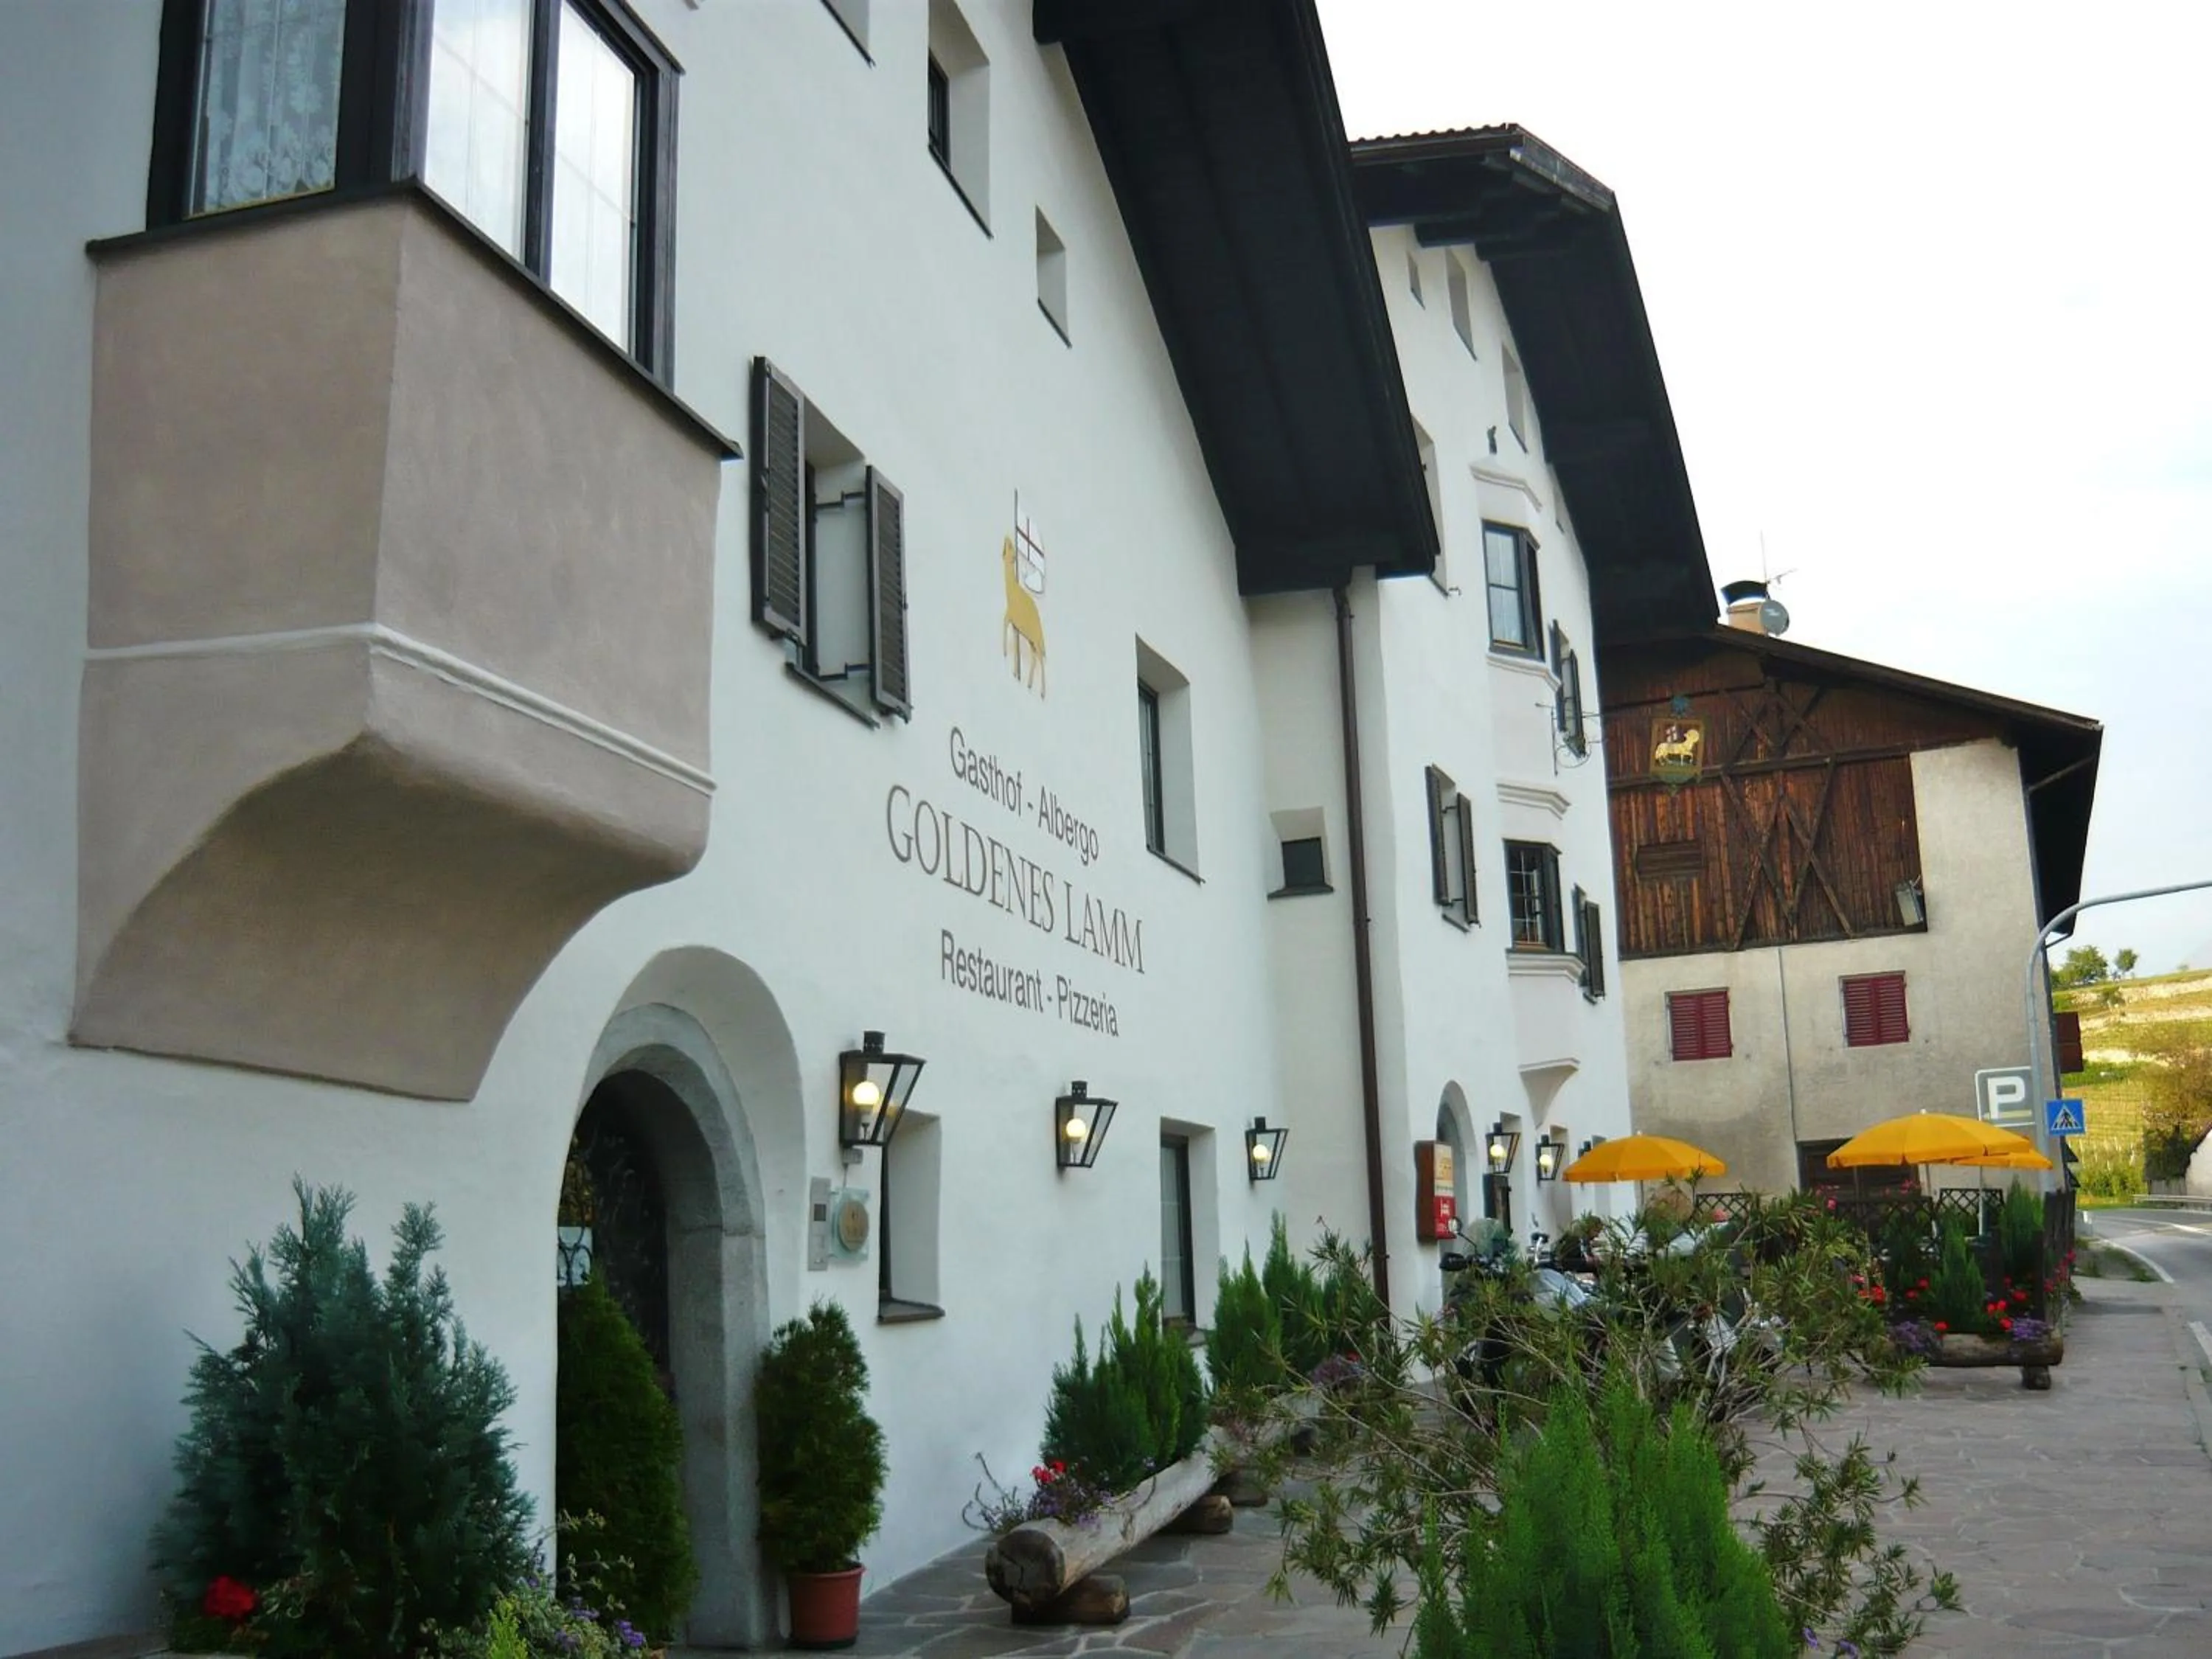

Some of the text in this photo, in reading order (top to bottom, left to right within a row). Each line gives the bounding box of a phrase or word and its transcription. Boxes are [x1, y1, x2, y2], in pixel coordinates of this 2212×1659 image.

[950, 726, 1022, 816] Gasthof
[1038, 785, 1099, 866] Albergo
[887, 784, 1145, 974] GOLDENES LAMM
[942, 929, 1044, 1013] Restaurant
[1057, 975, 1119, 1037] Pizzeria
[1987, 1076, 2025, 1119] P
